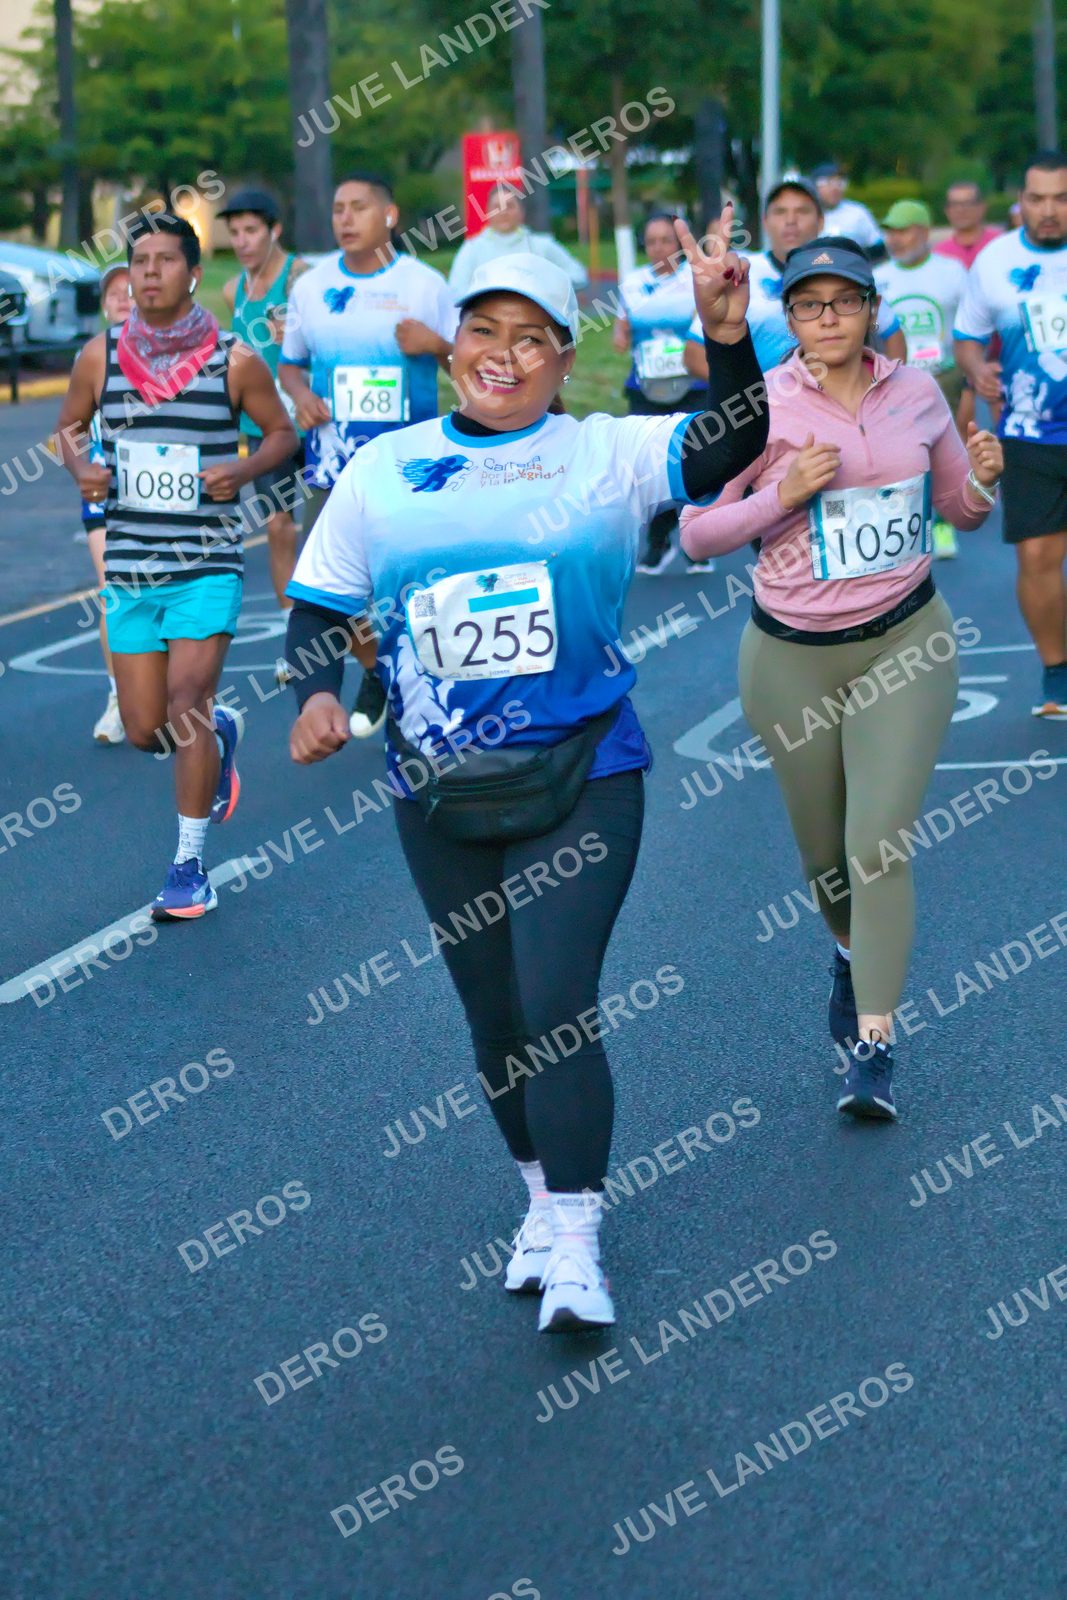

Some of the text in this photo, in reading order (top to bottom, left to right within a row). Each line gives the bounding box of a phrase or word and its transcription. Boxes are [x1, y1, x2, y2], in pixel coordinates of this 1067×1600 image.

[347, 390, 391, 414] 168
[122, 469, 195, 501] 1088
[833, 513, 922, 565] 1059
[424, 609, 554, 668] 1255
